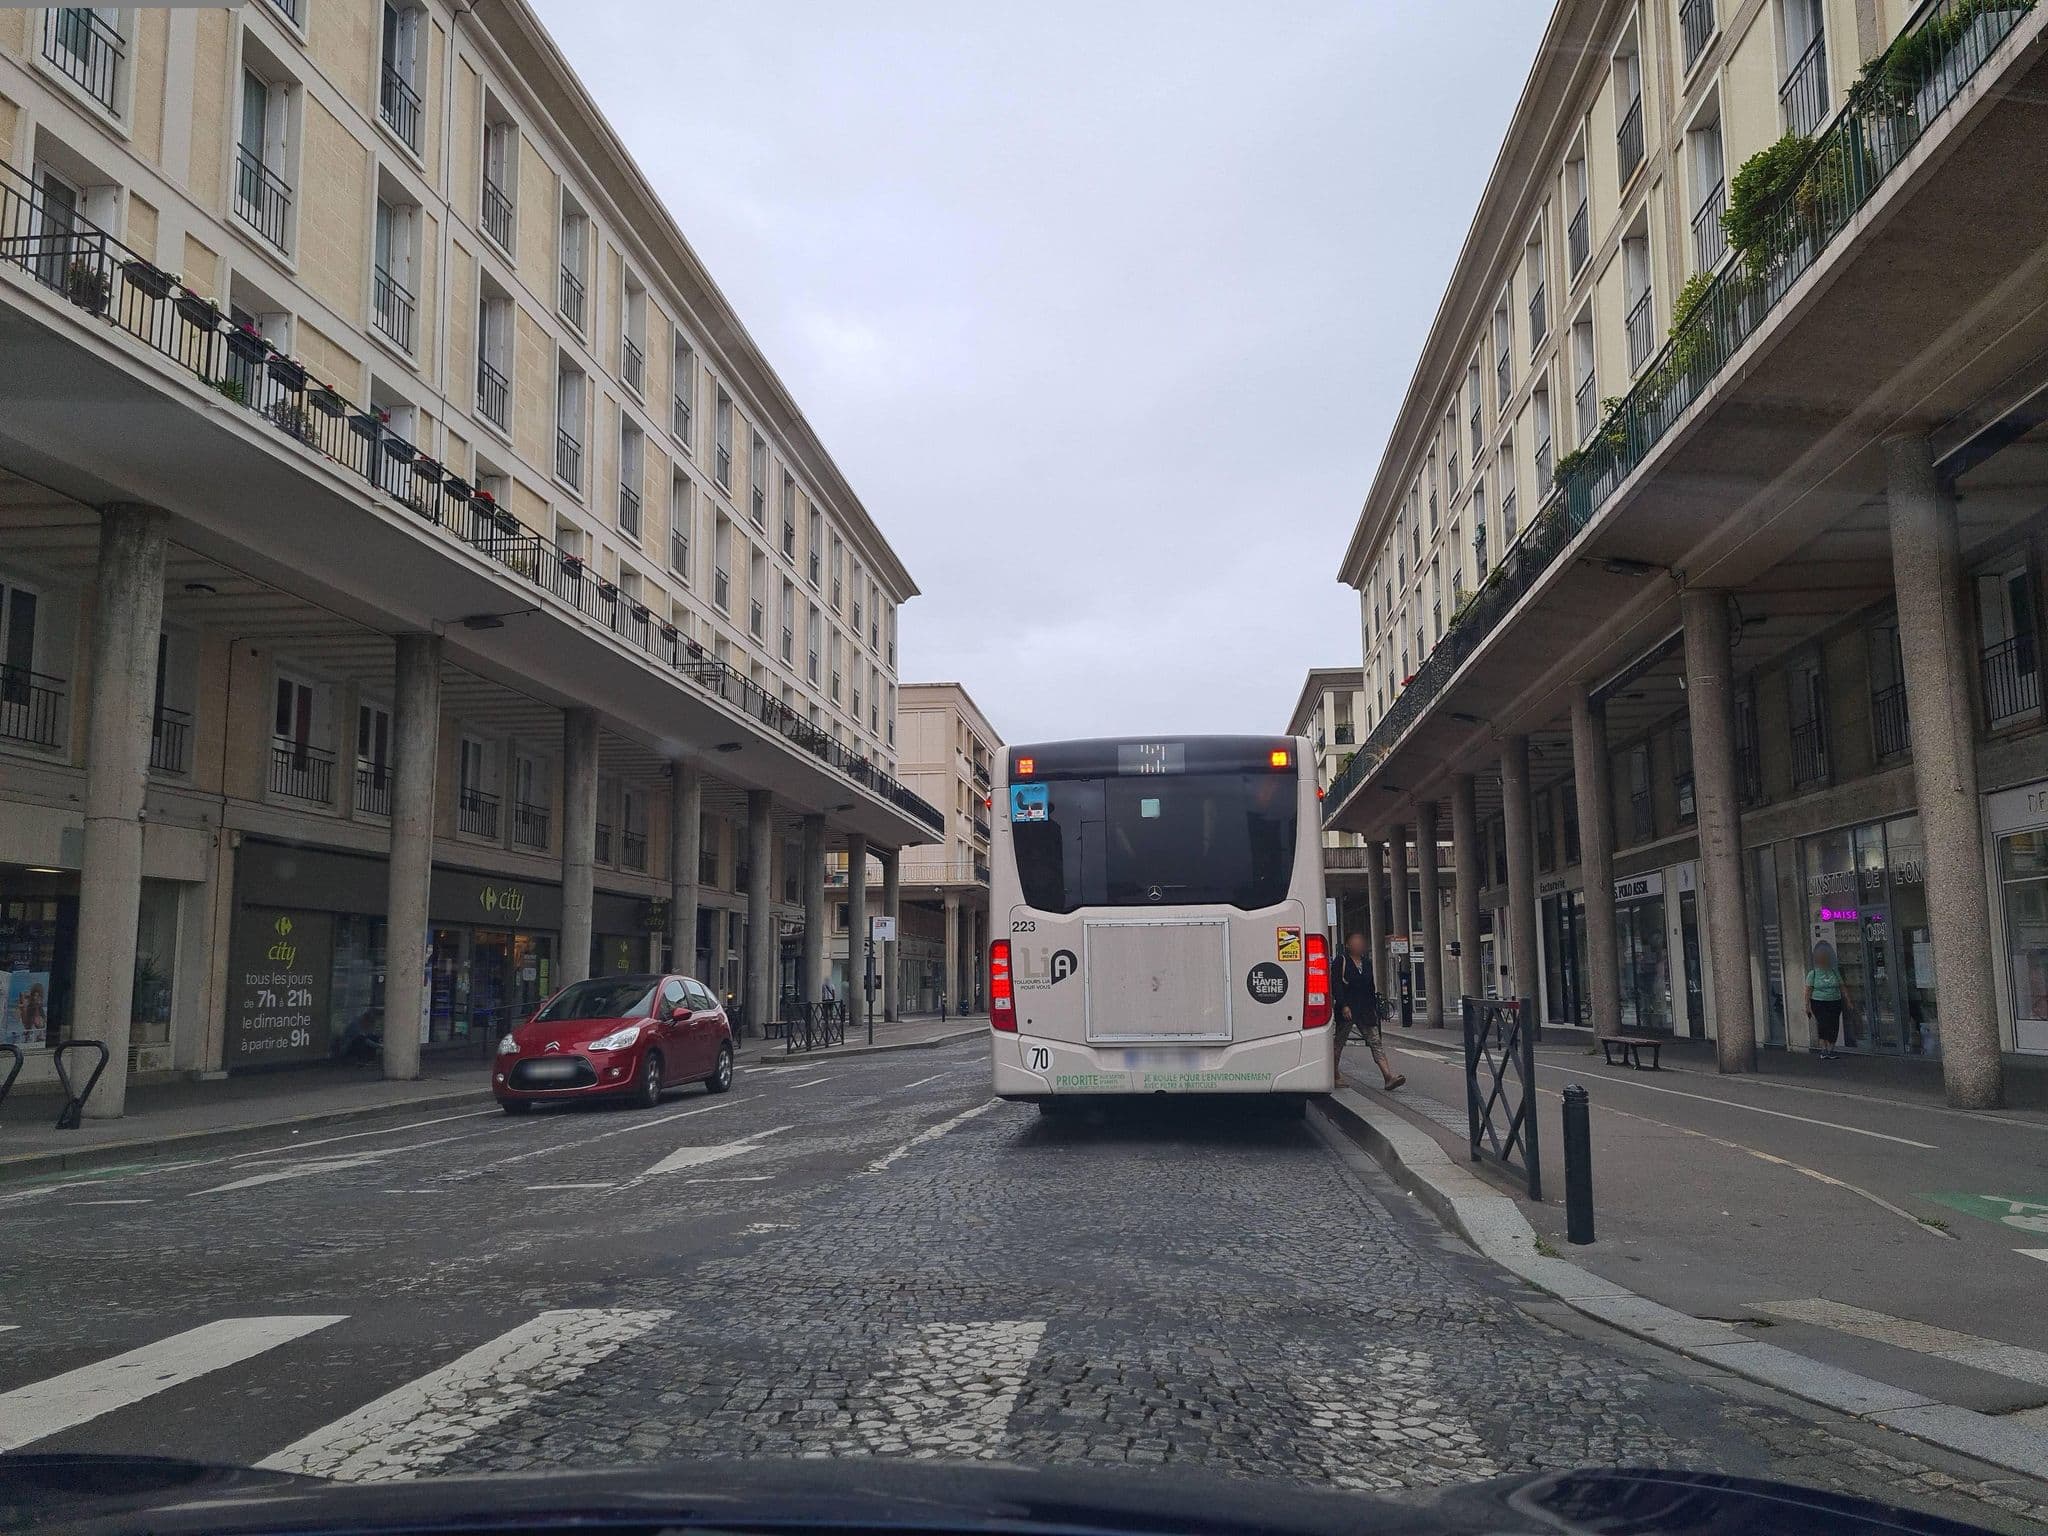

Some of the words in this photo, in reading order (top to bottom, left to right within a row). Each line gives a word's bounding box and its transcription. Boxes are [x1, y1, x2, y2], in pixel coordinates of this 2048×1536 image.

[1865, 866, 1881, 889] DE
[1618, 883, 1633, 898] POLO
[499, 887, 524, 922] city
[1833, 909, 1858, 920] MISE
[1012, 921, 1036, 932] 223
[268, 942, 296, 969] city
[246, 972, 270, 985] tous
[272, 972, 287, 985] les
[286, 973, 313, 988] jours
[1252, 971, 1264, 979] LE
[244, 1000, 254, 1008] de
[257, 989, 277, 1008] 7h
[287, 988, 312, 1007] 21h
[243, 1016, 252, 1028] le
[254, 1012, 310, 1028] dimanche
[241, 1038, 248, 1051] à
[249, 1036, 276, 1053] partir
[276, 1037, 288, 1048] de
[290, 1028, 310, 1047] 9h
[1031, 1047, 1049, 1070] 70
[1056, 1074, 1098, 1086] PRIORITE
[1144, 1072, 1152, 1082] JE
[1153, 1072, 1177, 1082] ROULE
[1179, 1072, 1200, 1082] POUR
[1202, 1072, 1271, 1081] L'ENVIRONNEMENT
